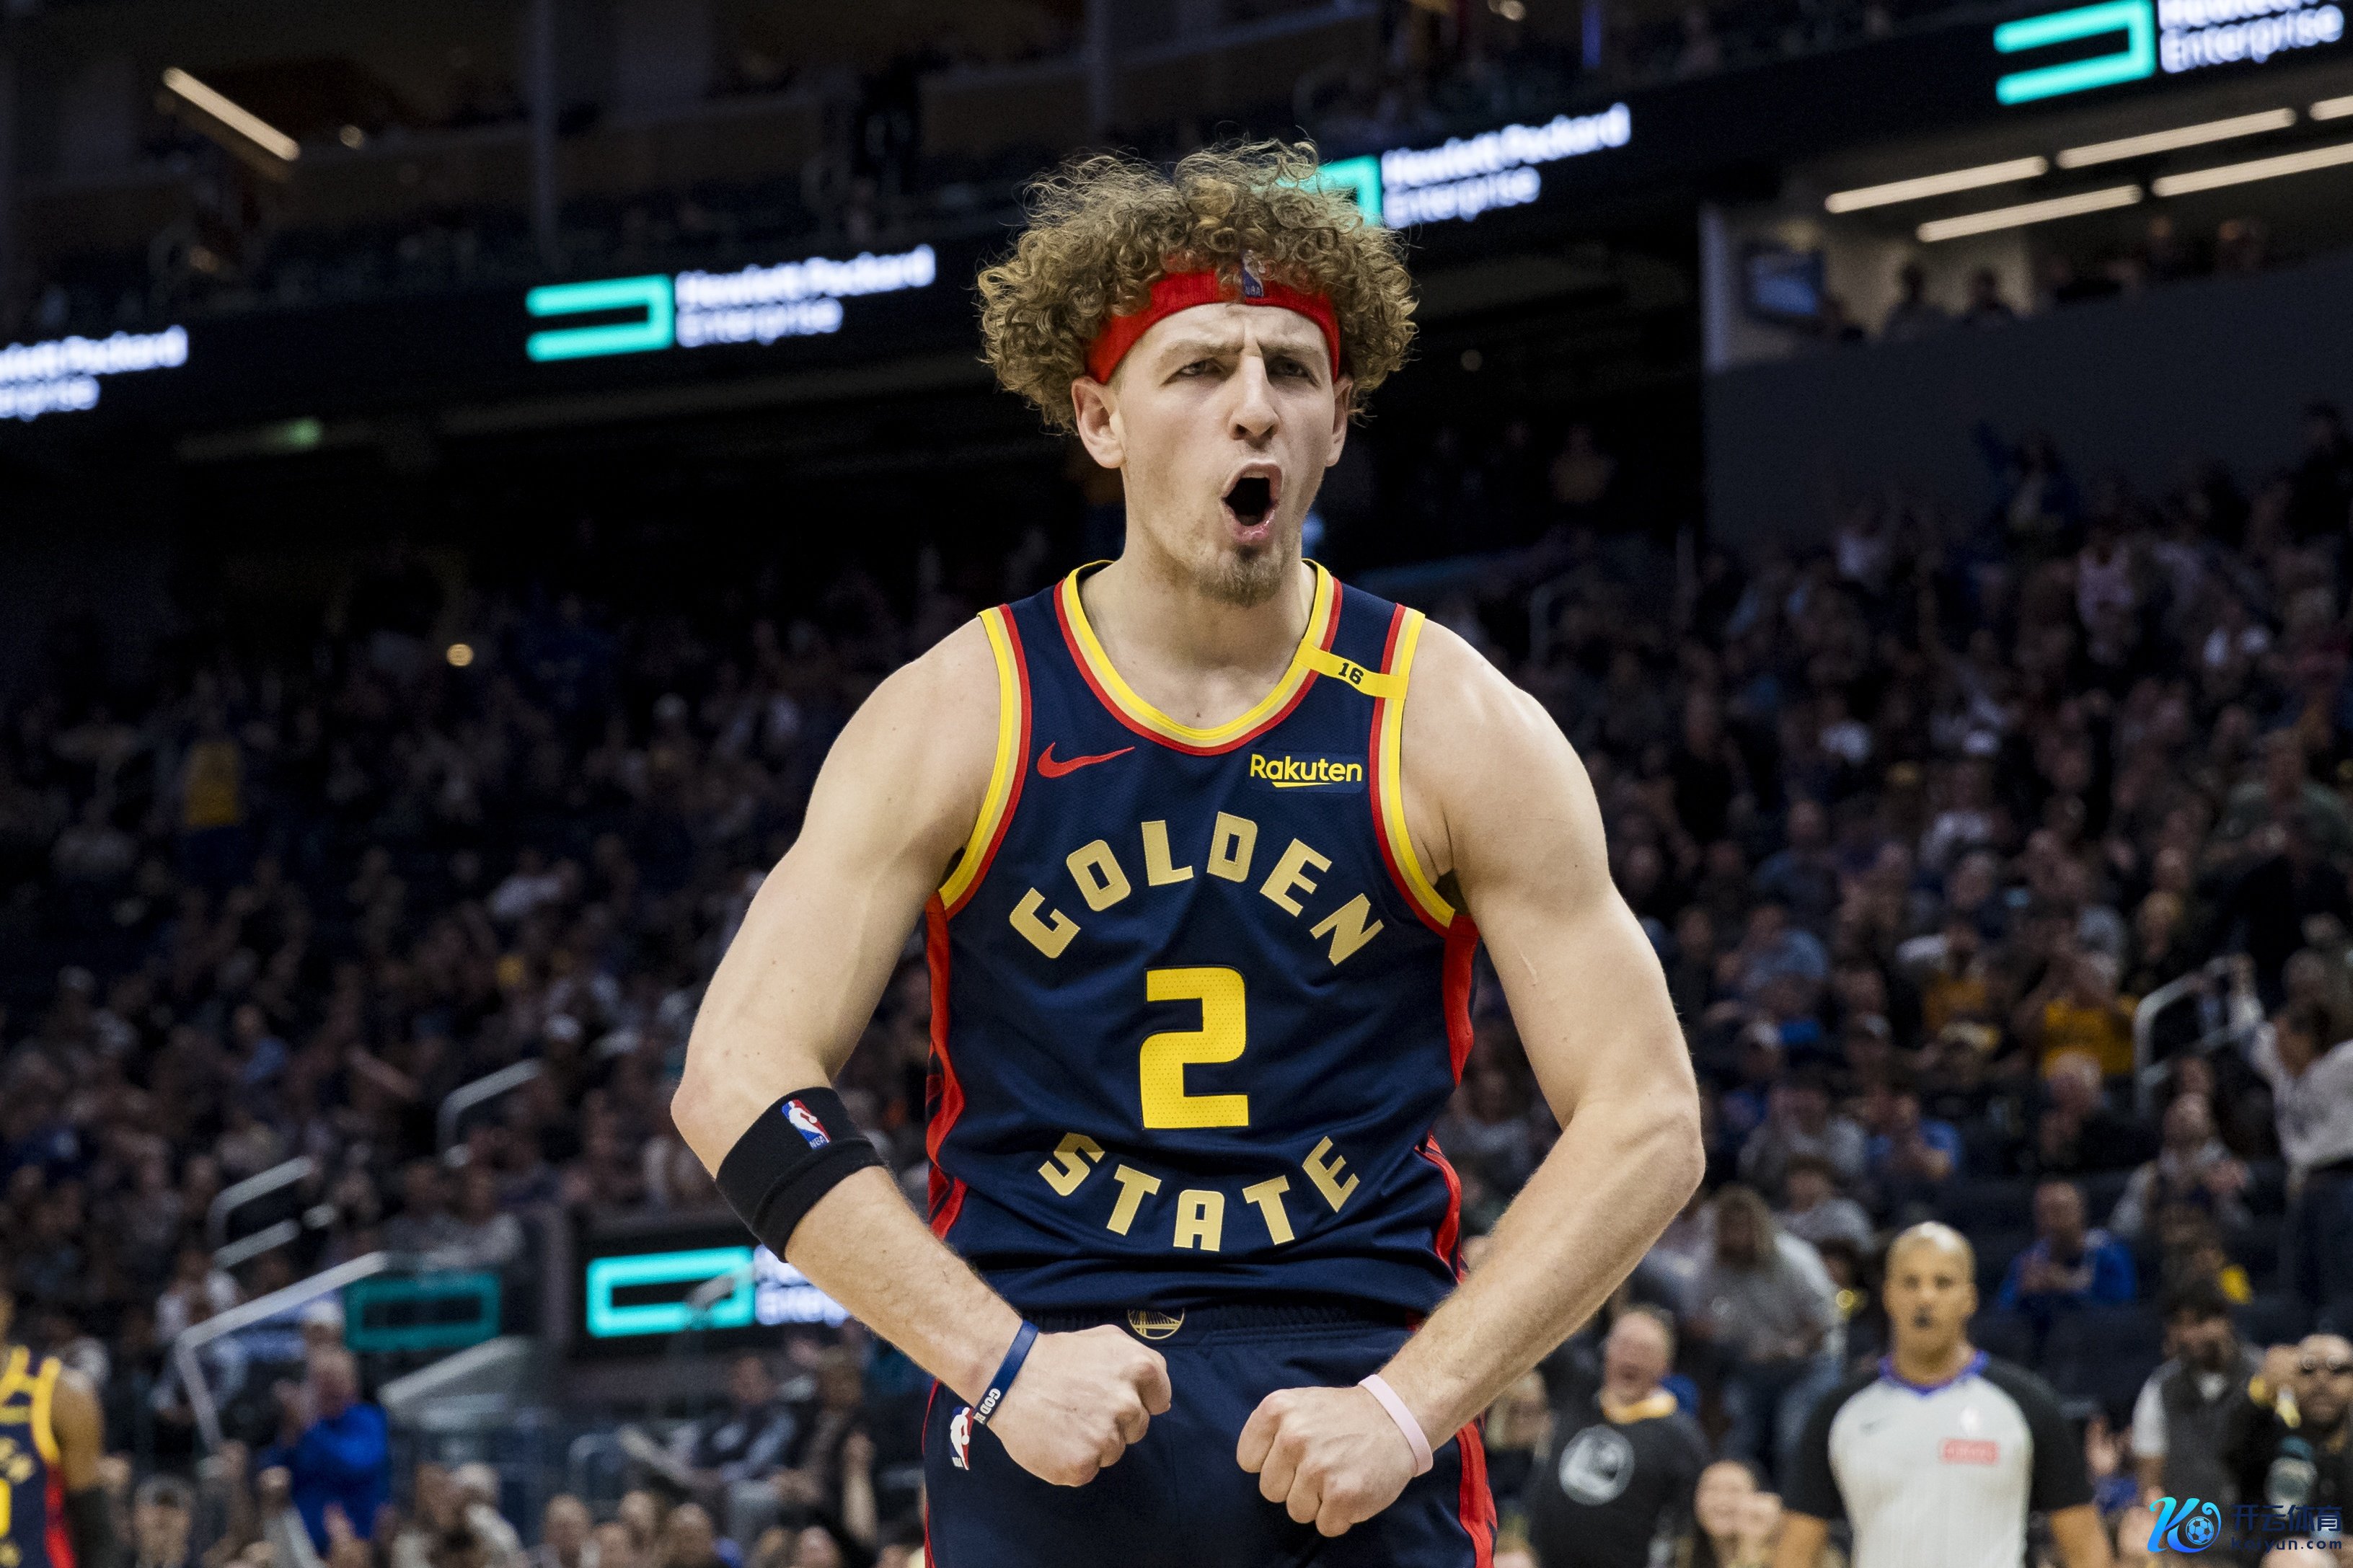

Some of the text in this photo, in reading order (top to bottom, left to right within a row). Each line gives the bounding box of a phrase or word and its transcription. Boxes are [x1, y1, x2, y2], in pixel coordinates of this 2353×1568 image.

[1338, 662, 1364, 685] 16
[1250, 753, 1362, 782] Rakuten
[1010, 811, 1384, 966] GOLDEN
[1139, 966, 1249, 1130] 2
[809, 1135, 826, 1148] NBA
[1038, 1133, 1360, 1252] STATE
[979, 1388, 1001, 1414] GOD
